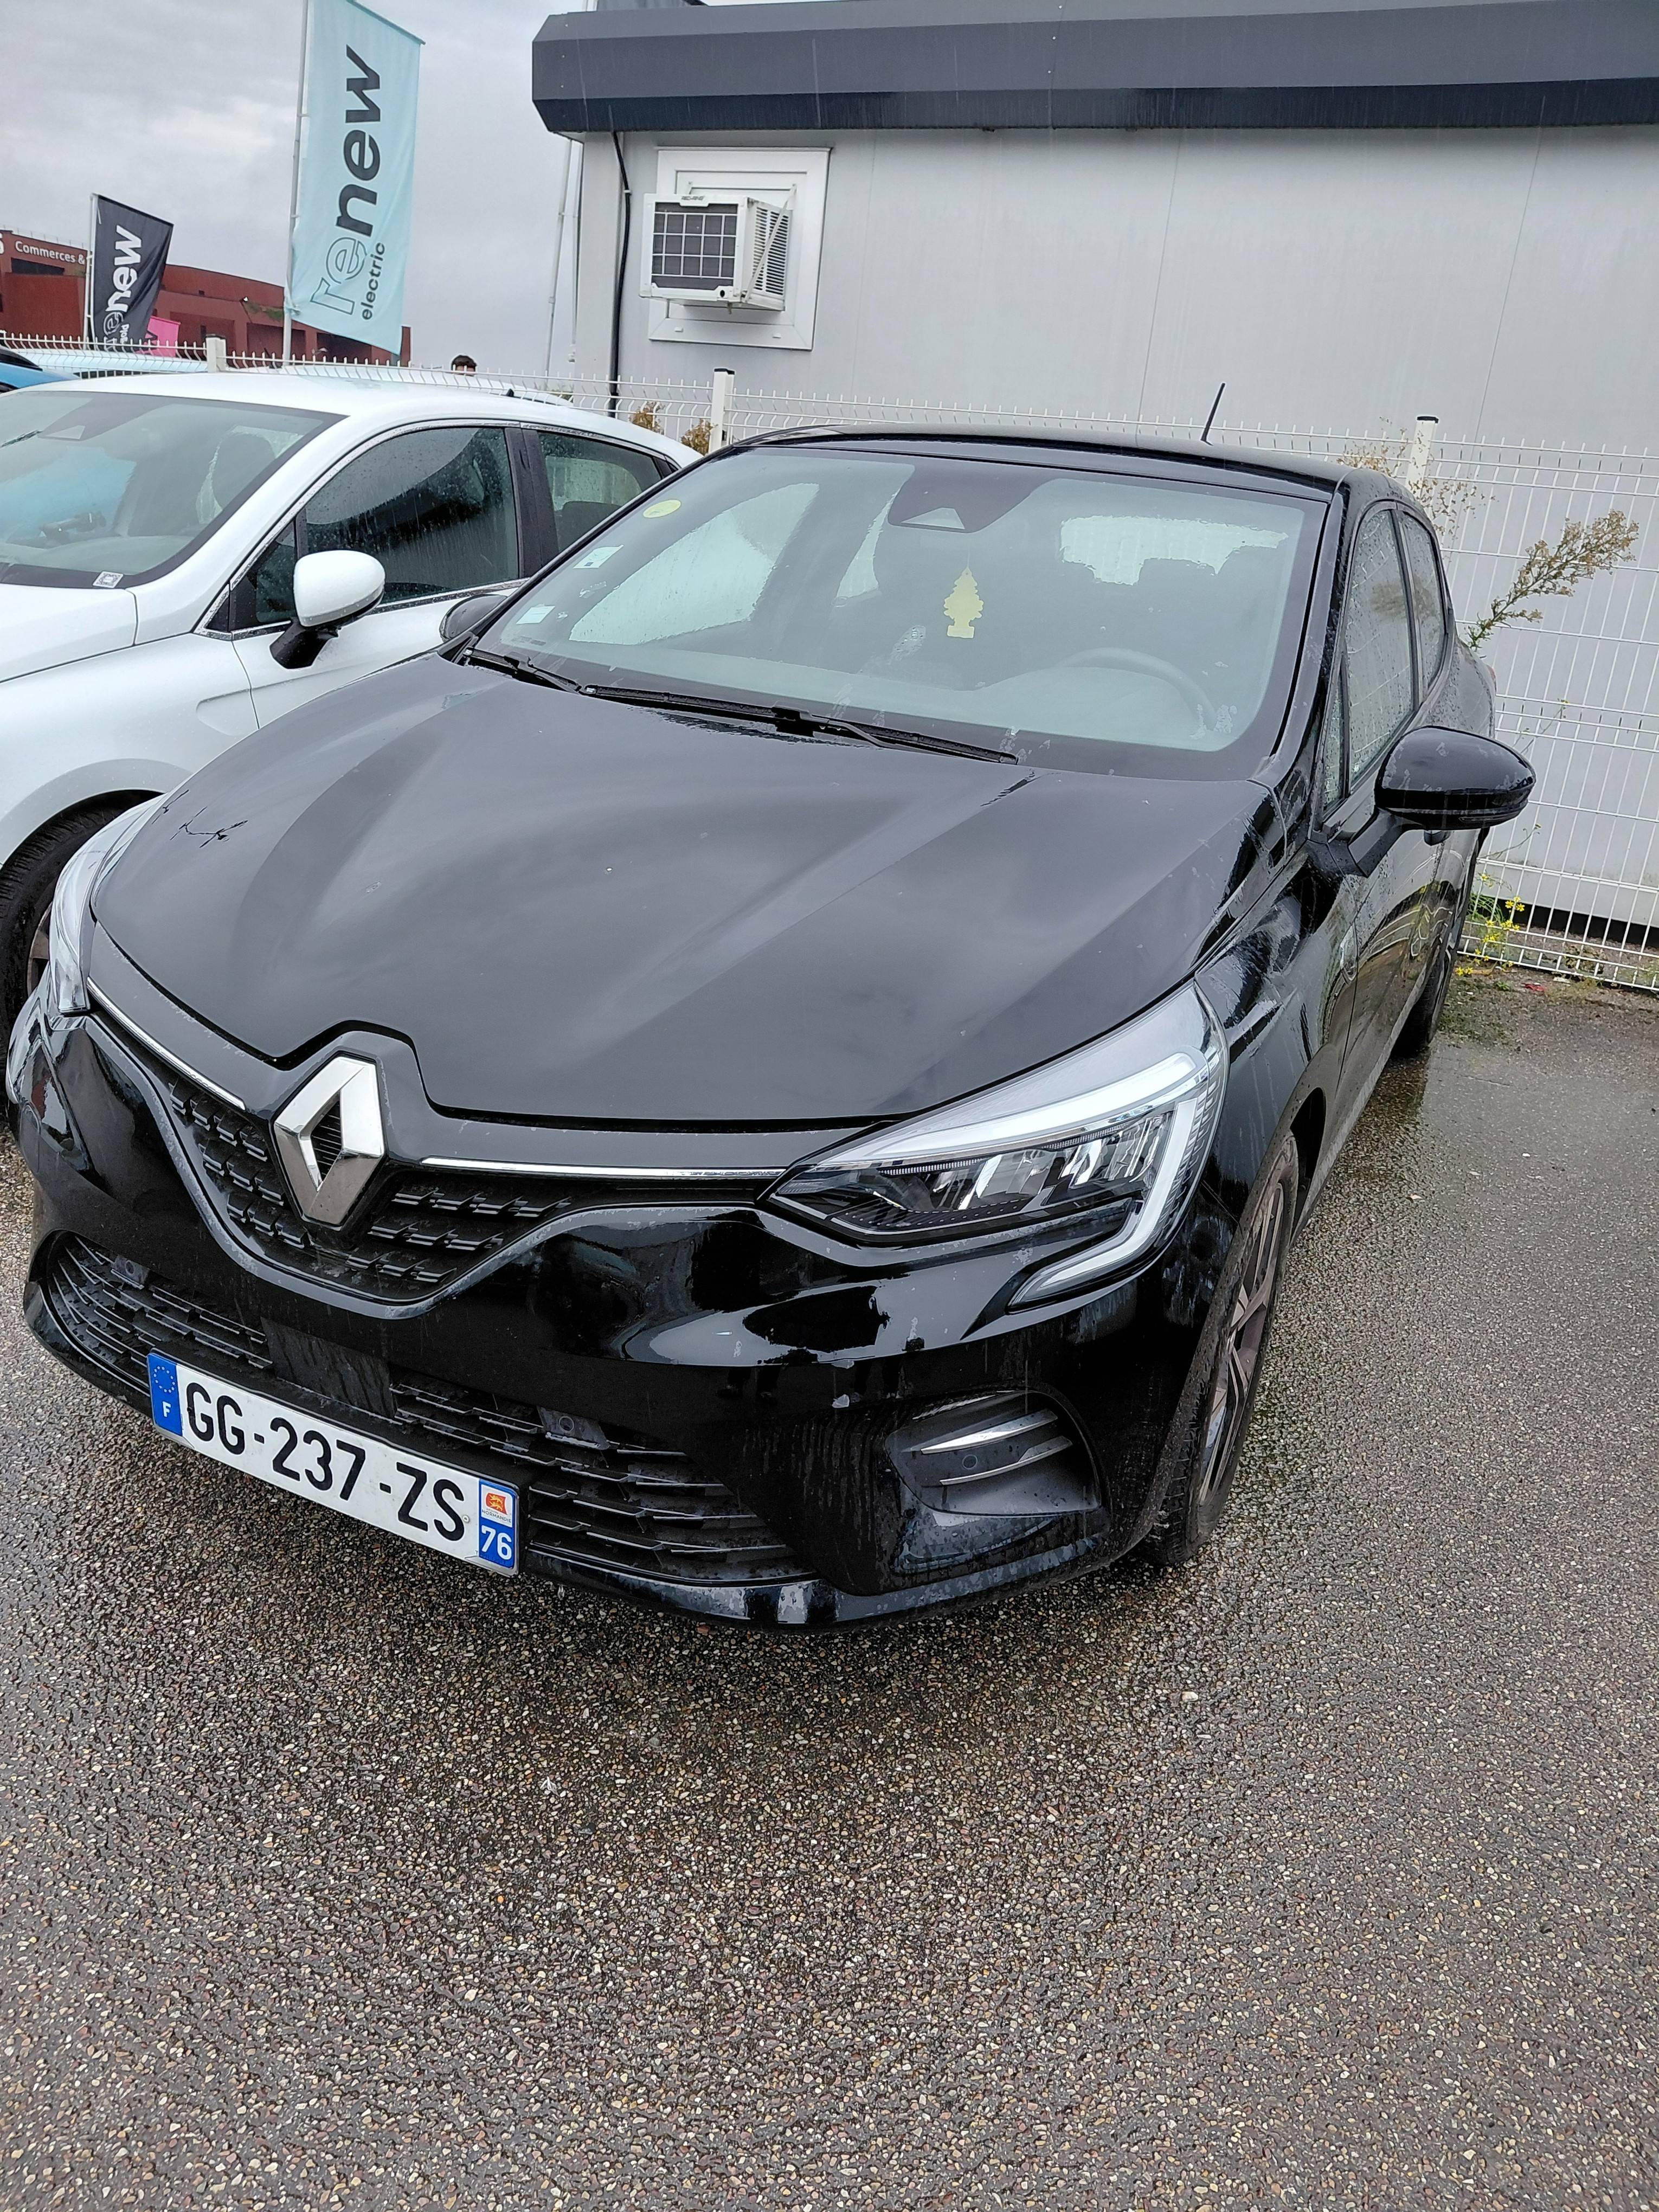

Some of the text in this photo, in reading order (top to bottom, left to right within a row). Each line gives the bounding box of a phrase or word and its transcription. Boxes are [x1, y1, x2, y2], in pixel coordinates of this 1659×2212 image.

[310, 44, 381, 316] renew
[15, 241, 76, 263] Commerces
[78, 254, 85, 265] &
[361, 241, 385, 321] electric
[162, 1401, 171, 1418] F
[186, 1382, 465, 1541] GG-237-ZS
[481, 1509, 512, 1523] NORMANDIE
[481, 1525, 512, 1560] 76
